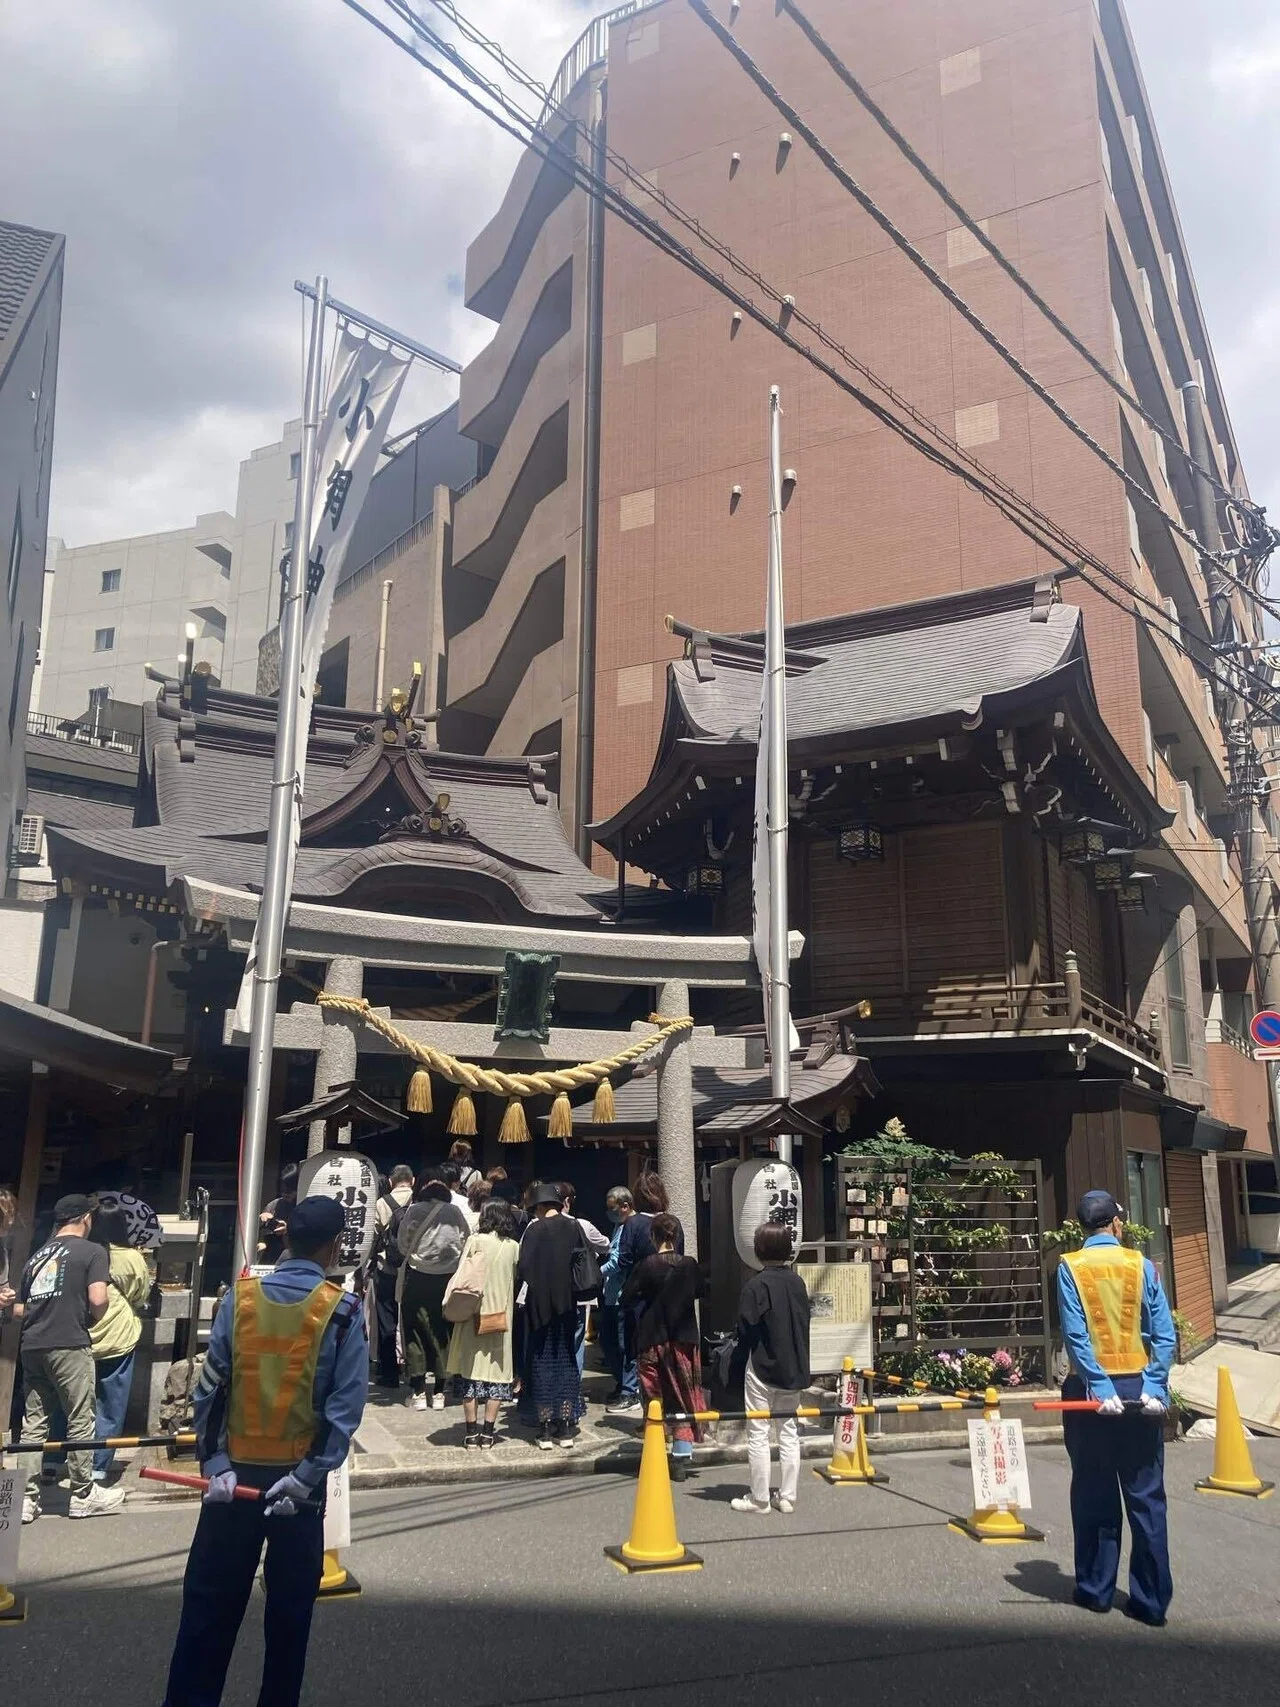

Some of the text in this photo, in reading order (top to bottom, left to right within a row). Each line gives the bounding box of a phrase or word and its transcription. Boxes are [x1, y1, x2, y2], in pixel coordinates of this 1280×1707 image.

[991, 1425, 1007, 1485] 写真撮影
[1007, 1425, 1019, 1467] 道路での
